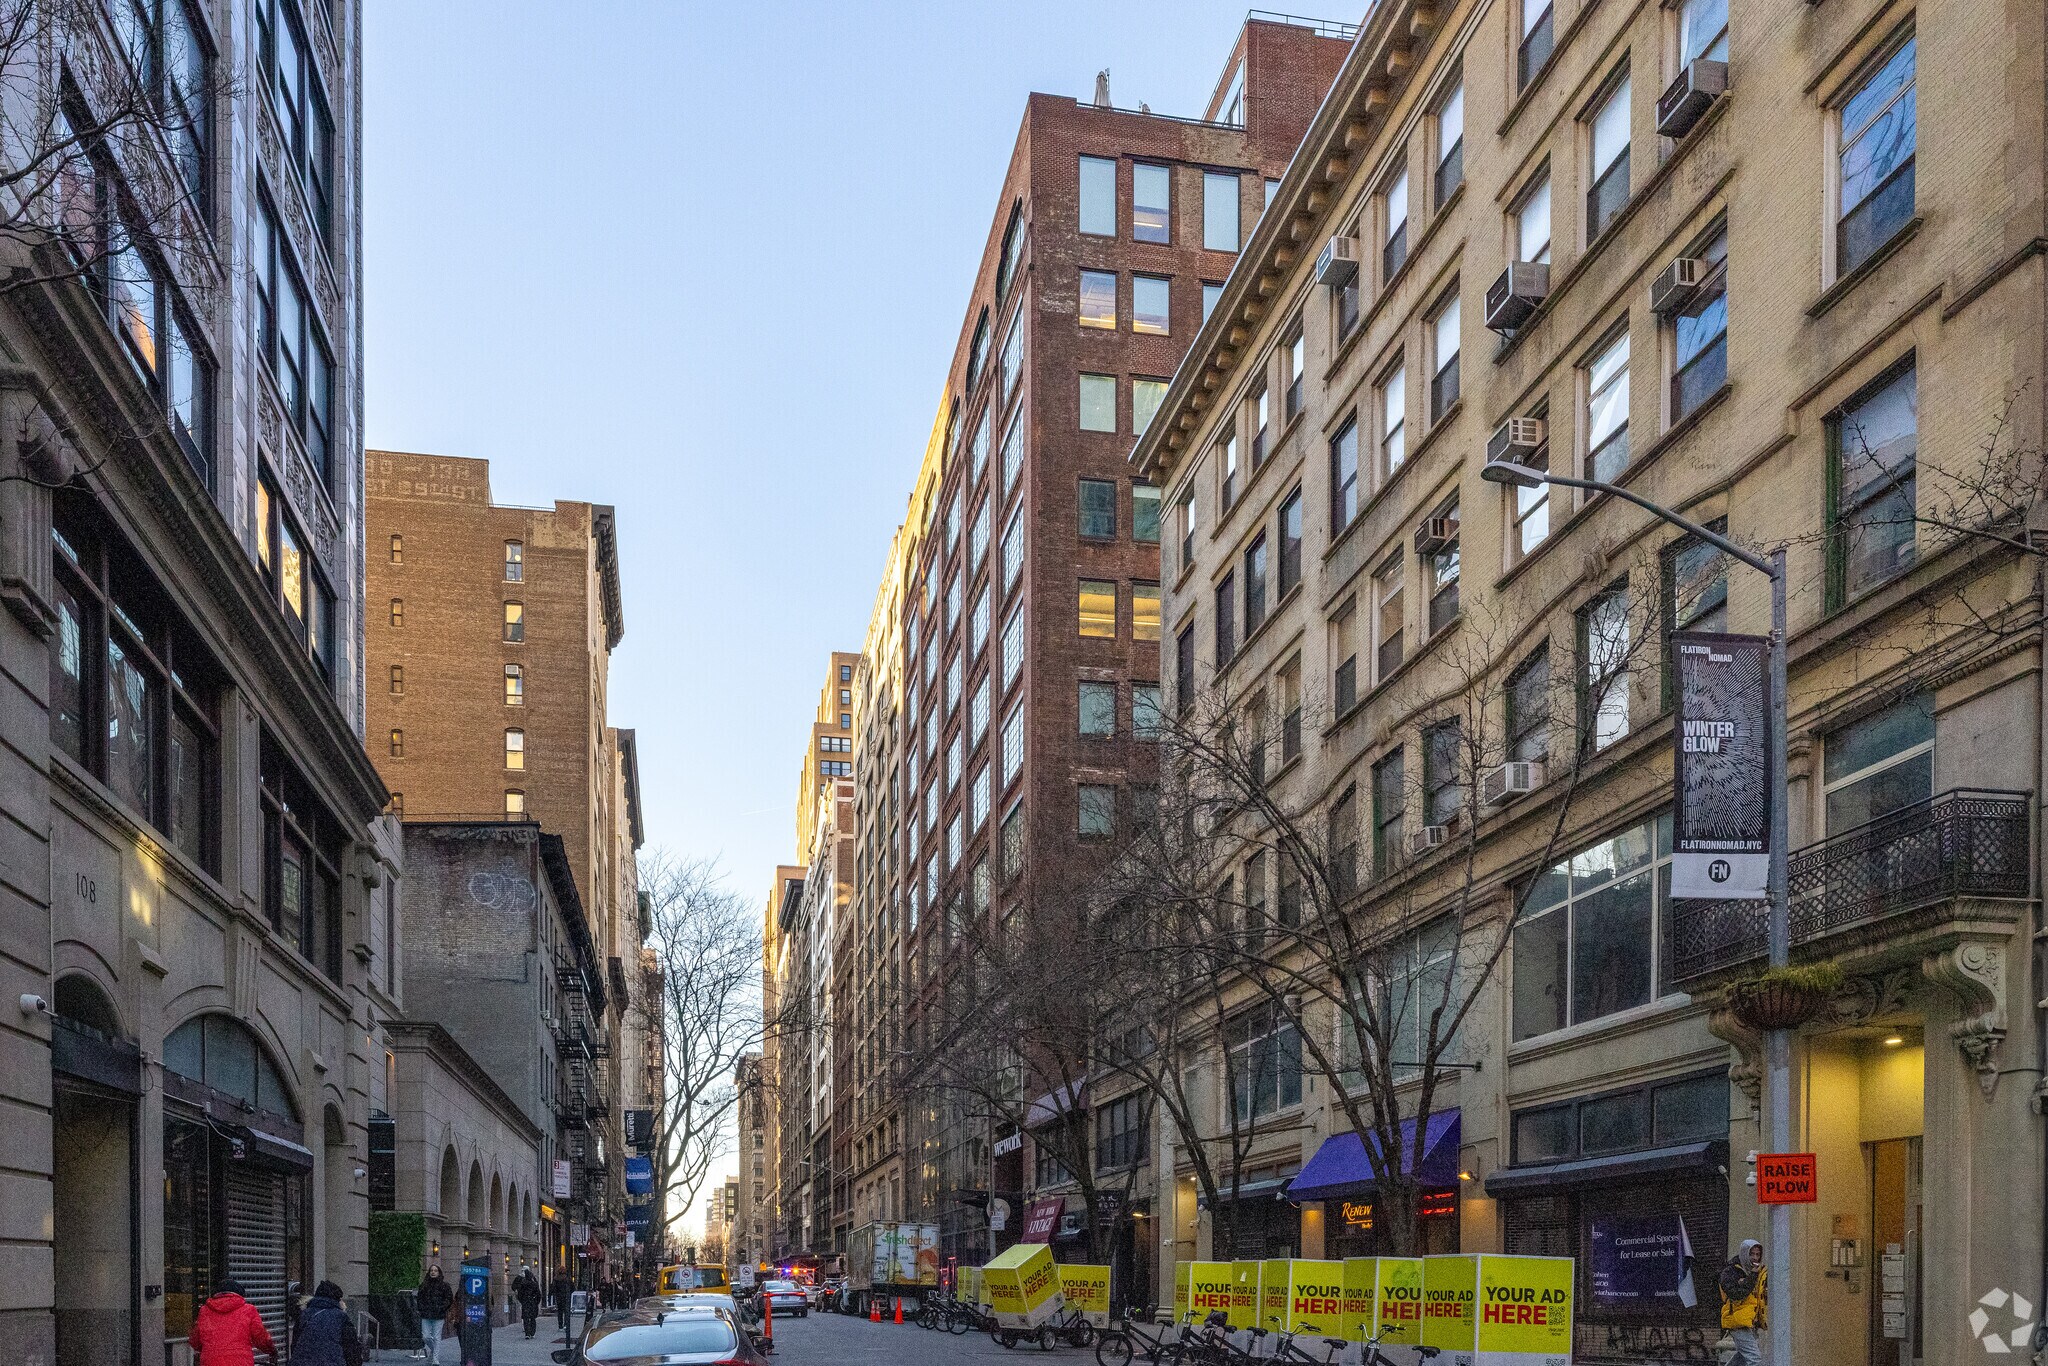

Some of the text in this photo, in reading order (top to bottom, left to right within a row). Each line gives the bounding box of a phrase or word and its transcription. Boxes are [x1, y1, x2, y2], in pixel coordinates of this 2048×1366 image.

[1681, 646, 1710, 654] FLATIRON
[1709, 654, 1732, 662] NOMAD
[1683, 721, 1734, 738] WINTER
[1683, 738, 1720, 752] GLOW
[1681, 840, 1762, 850] FLATIRONNOMAD.NYC
[1711, 864, 1728, 878] FN
[76, 872, 96, 904] 108
[1764, 1163, 1810, 1178] RAISE
[1766, 1181, 1810, 1194] PLOW
[1615, 1234, 1679, 1246] Commercial Spaces
[1620, 1251, 1630, 1259] for
[1631, 1250, 1650, 1258] Lease
[1660, 1248, 1675, 1256] Sale
[1023, 1261, 1052, 1286] YOUR AD
[472, 1278, 482, 1293] P
[1025, 1274, 1048, 1298] HERE
[1062, 1280, 1106, 1288] YOUR AD
[1062, 1288, 1095, 1298] HERE
[1233, 1286, 1256, 1295] YOUR AD
[1267, 1287, 1280, 1296] YOUR
[1296, 1285, 1340, 1297] YOUR
[1344, 1288, 1373, 1299] YOUR AD
[1426, 1290, 1474, 1301] YOUR AD
[1486, 1286, 1566, 1304] YOUR AD
[1232, 1296, 1251, 1306] HERE
[1267, 1296, 1282, 1307] HERE
[1344, 1300, 1366, 1313] HERE
[1425, 1303, 1462, 1318] HERE
[1484, 1304, 1547, 1325] HERE
